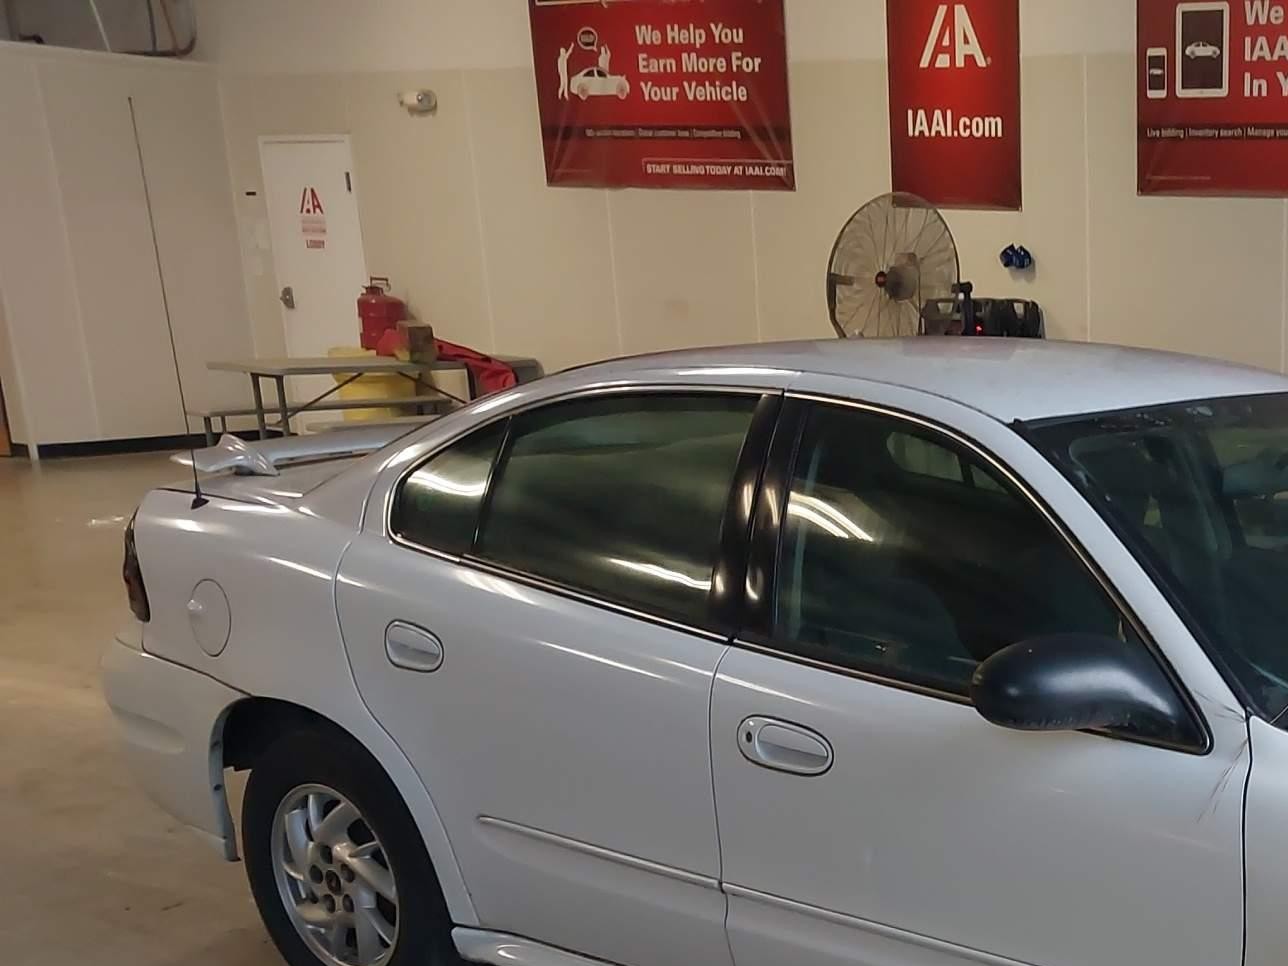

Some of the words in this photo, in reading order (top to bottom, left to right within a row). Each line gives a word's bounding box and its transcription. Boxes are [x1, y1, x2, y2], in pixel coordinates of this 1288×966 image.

[1244, 0, 1283, 26] We
[635, 25, 661, 46] We
[667, 24, 705, 48] Help
[709, 23, 744, 44] You
[638, 53, 676, 74] Earn
[682, 53, 727, 73] More
[732, 52, 762, 72] For
[640, 81, 678, 102] Your
[684, 80, 747, 102] Vehicle
[1244, 72, 1267, 97] In
[907, 109, 1003, 137] IAAI.com
[646, 163, 670, 174] START
[672, 164, 705, 175] SELLING
[705, 165, 732, 176] TODAY
[733, 165, 743, 176] AT
